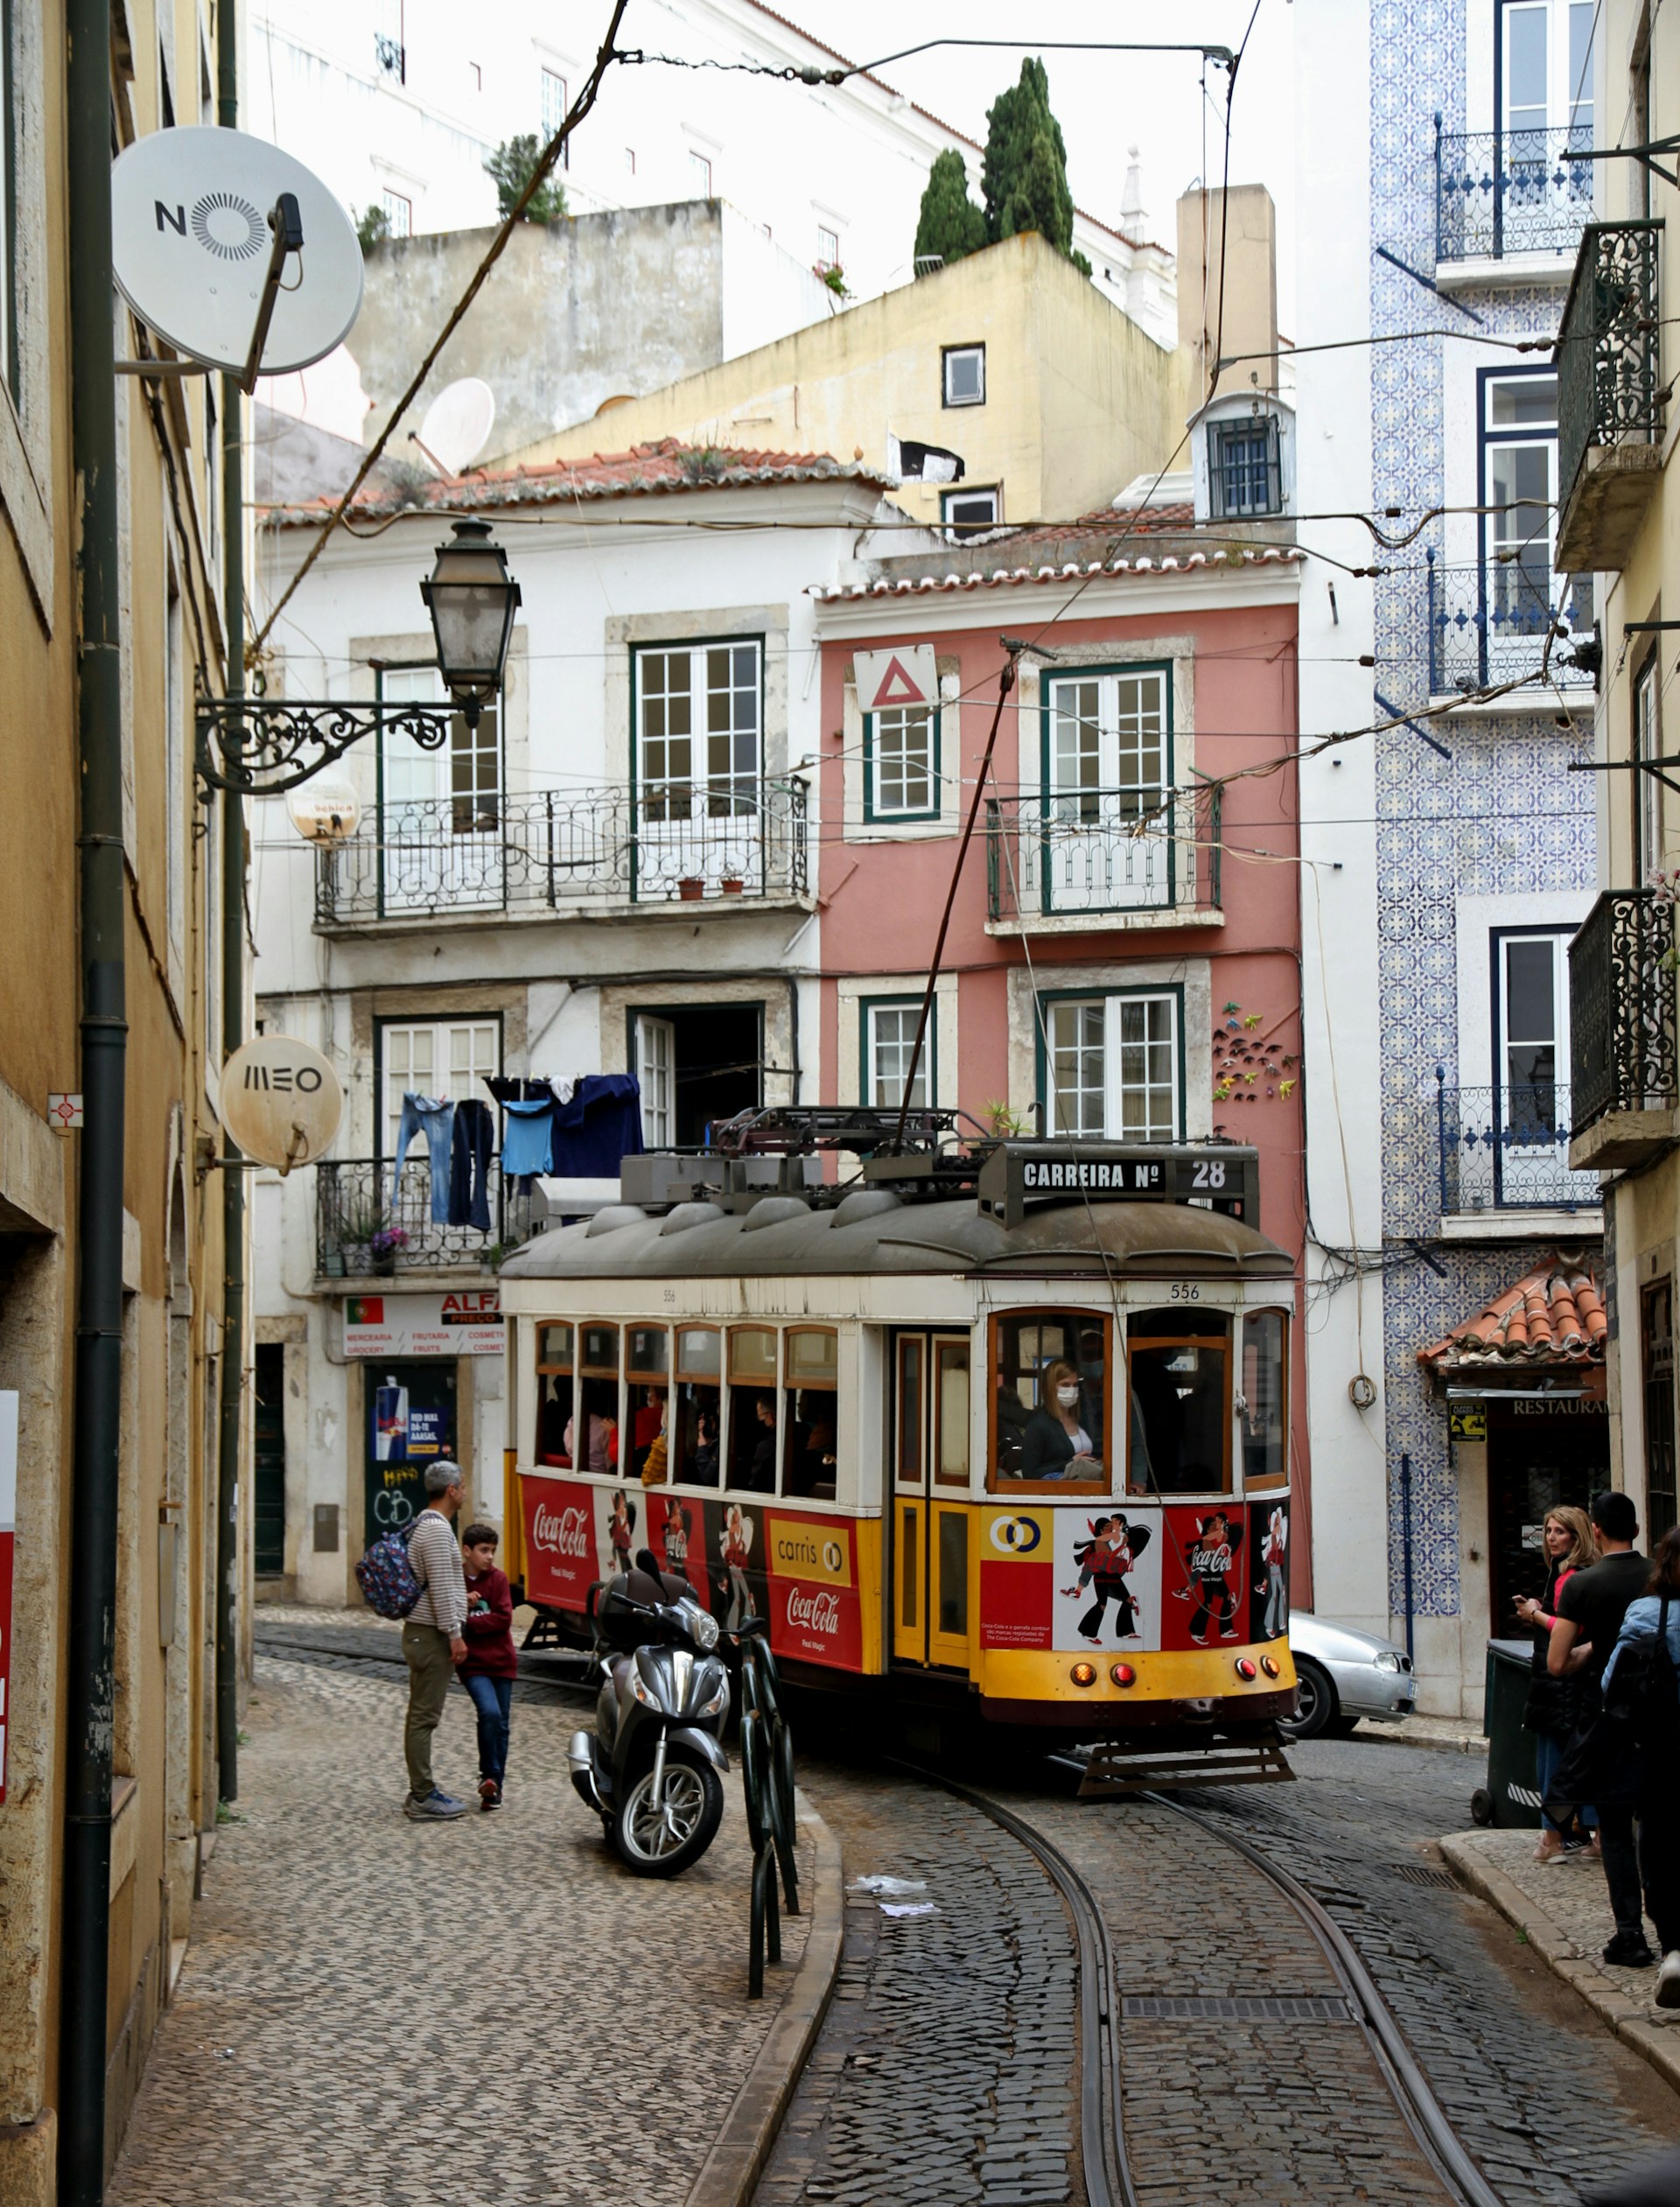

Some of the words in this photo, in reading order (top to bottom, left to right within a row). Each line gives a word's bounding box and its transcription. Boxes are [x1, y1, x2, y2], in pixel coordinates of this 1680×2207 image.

[154, 192, 266, 261] NO
[244, 1065, 322, 1093] MEO
[1024, 1162, 1124, 1188] CARREIRA
[1135, 1165, 1159, 1188] Nº
[1191, 1160, 1226, 1188] 28
[663, 1289, 676, 1302] 556
[1171, 1284, 1199, 1300] 556
[451, 1314, 496, 1324] PREÇO
[346, 1333, 393, 1342] MERCEARIA
[411, 1331, 450, 1341] FRUTARIA
[468, 1330, 504, 1340] COSMÉTI
[346, 1346, 385, 1355] GROCERY
[412, 1344, 441, 1353] FRUITS
[410, 1412, 424, 1422] RED
[424, 1412, 439, 1422] BULL
[532, 1503, 589, 1559] Coca-Cola
[778, 1536, 817, 1564] carris
[787, 1587, 840, 1635] Coca-Cola
